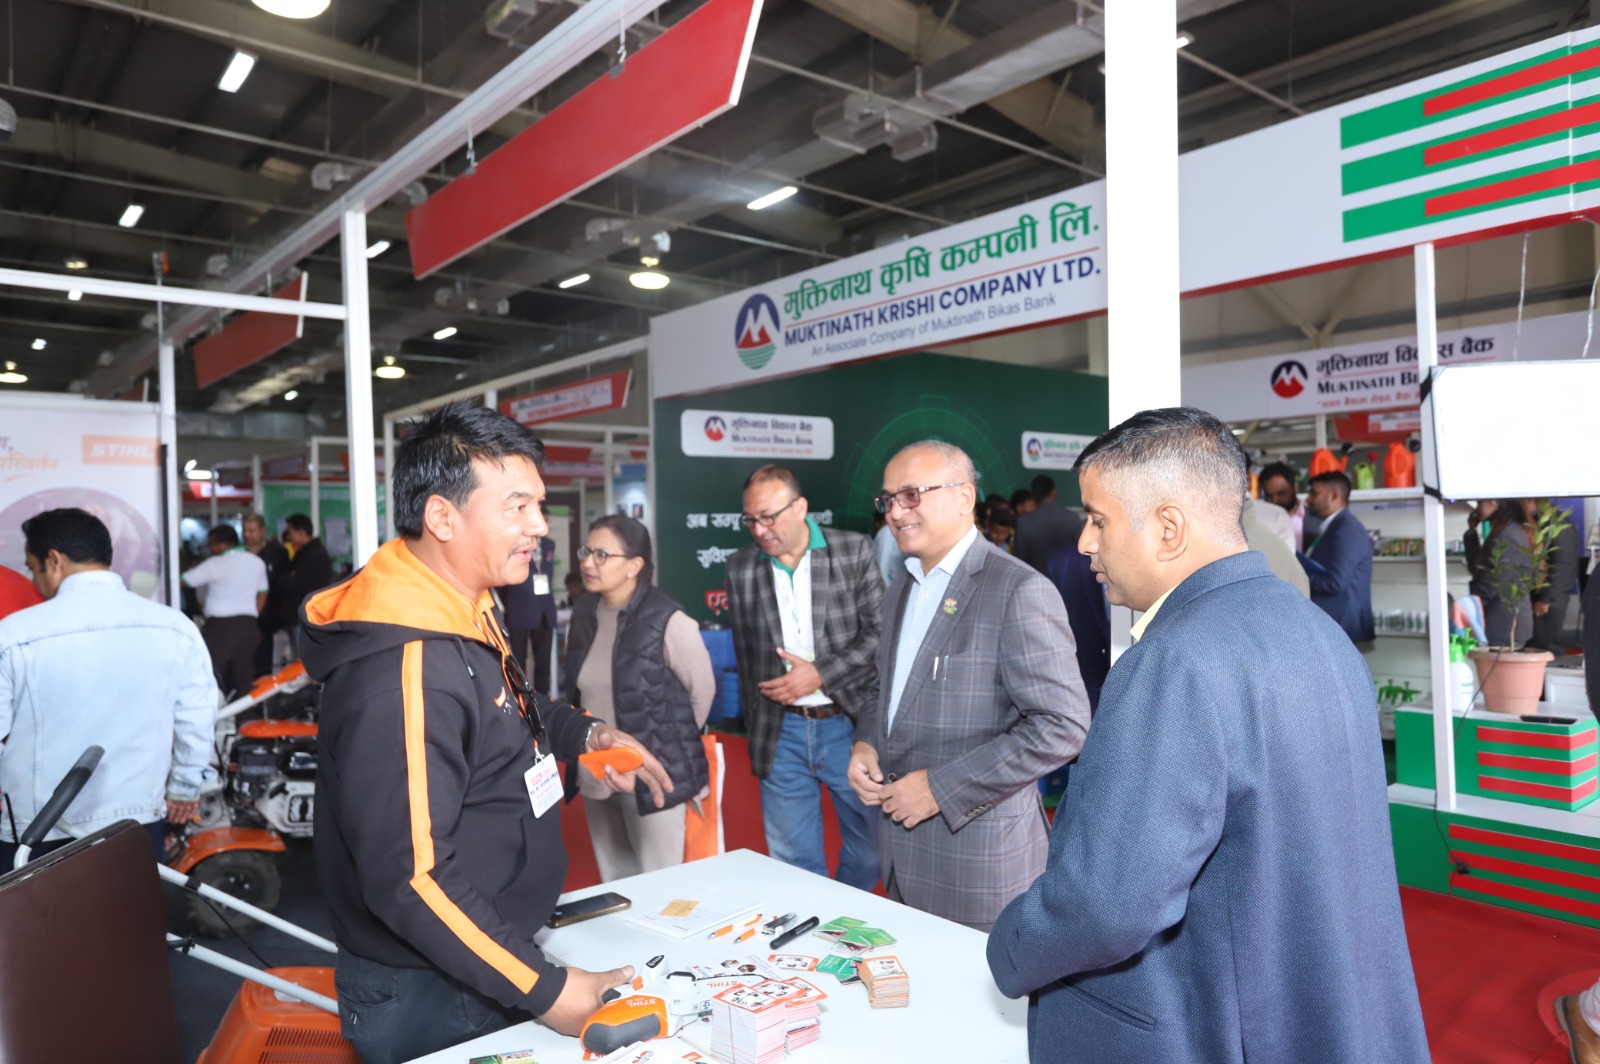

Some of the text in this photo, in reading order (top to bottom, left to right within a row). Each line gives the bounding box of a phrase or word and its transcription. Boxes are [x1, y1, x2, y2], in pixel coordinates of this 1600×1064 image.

[784, 202, 1099, 320] मुक्तिनाथ कृषि कम्पनी लि.
[785, 256, 1101, 347] MUKTINATH KRISHI COMPANY LTD.
[811, 293, 1056, 357] An Associate Company of Muktinath Bikas Bank
[1317, 350, 1389, 375] मुक्तिनाथ
[1317, 376, 1395, 394] MUKTINATH
[91, 442, 155, 459] STIHL
[686, 513, 708, 528] अब
[626, 998, 656, 1007] STIHL
